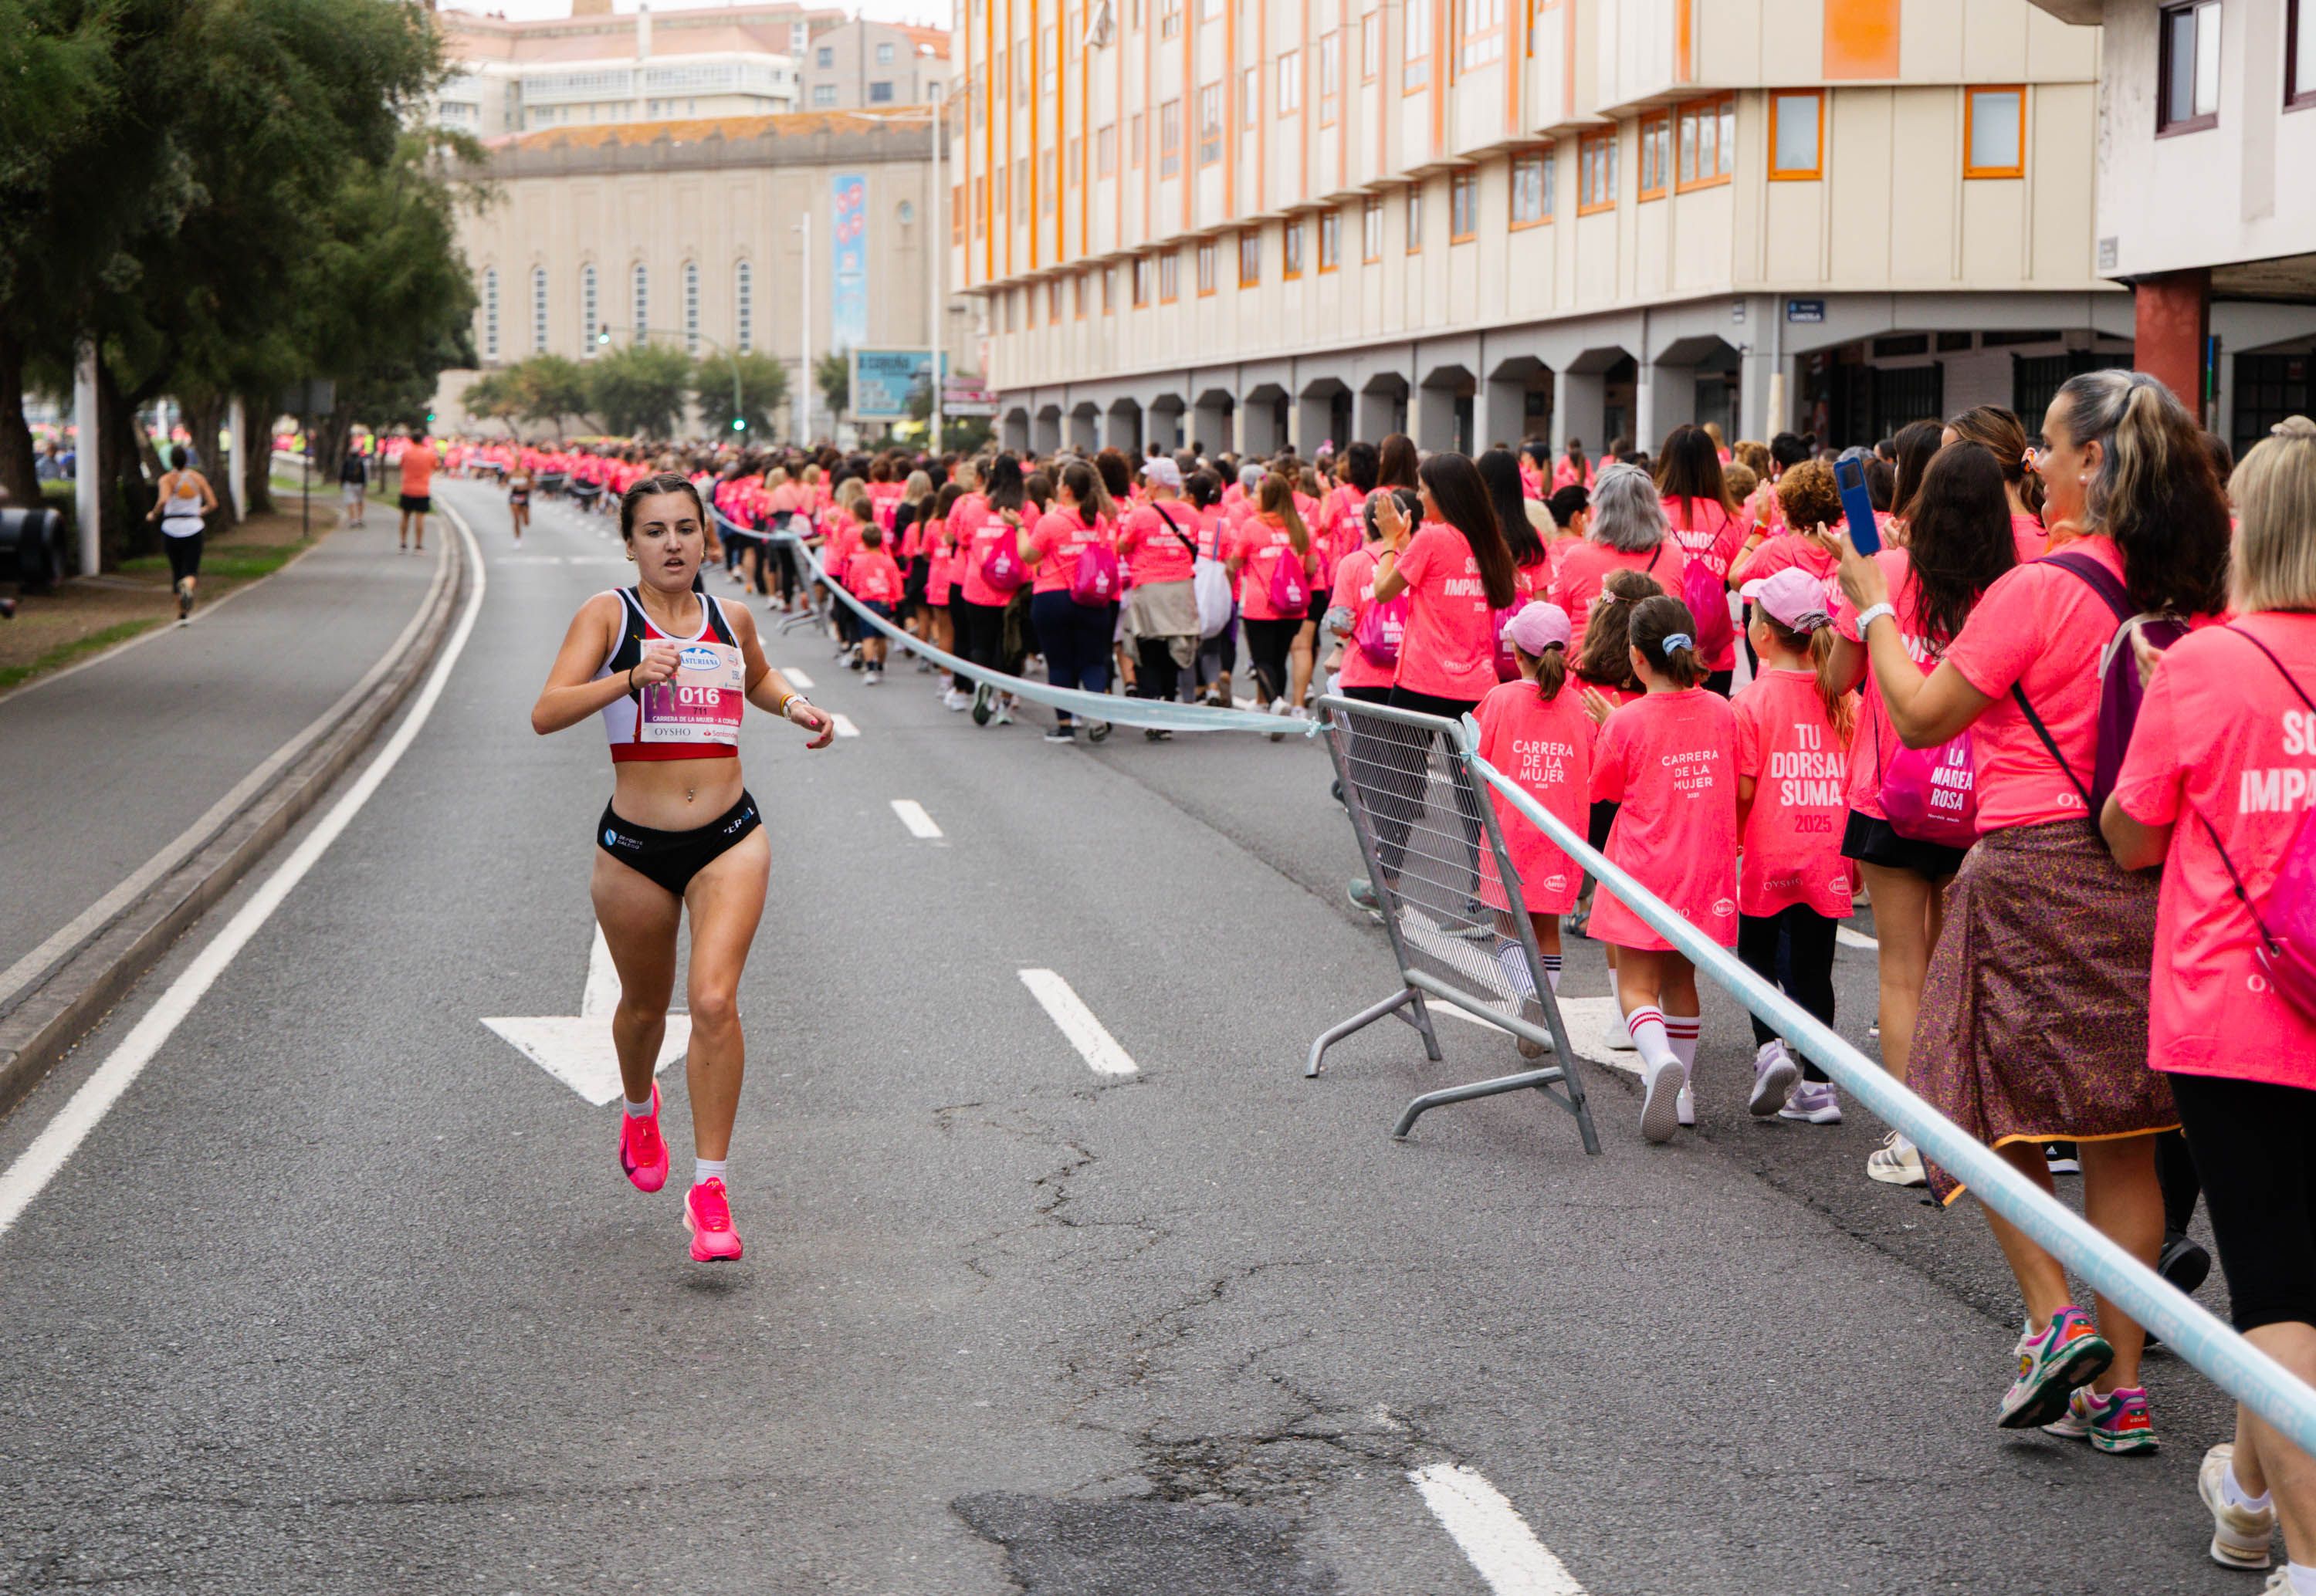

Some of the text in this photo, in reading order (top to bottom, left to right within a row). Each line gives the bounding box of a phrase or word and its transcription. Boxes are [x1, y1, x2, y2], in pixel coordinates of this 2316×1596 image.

[679, 686, 720, 705] 016
[693, 707, 707, 715] 711
[655, 728, 691, 736] OYSHO
[1794, 723, 1821, 750] TU
[1512, 740, 1574, 757] CARRERA
[1522, 754, 1563, 769] DE LA
[1661, 749, 1719, 766] CARRERA
[1948, 748, 1964, 767] LA
[1519, 767, 1564, 783] MUJER
[1674, 765, 1710, 777] DE LA
[1930, 766, 1973, 790] MAREA
[1674, 776, 1712, 790] MUJER
[1780, 779, 1844, 806] SUMA
[1930, 788, 1963, 810] ROSA
[1795, 814, 1832, 833] 2025
[1763, 877, 1803, 891] OYSHO
